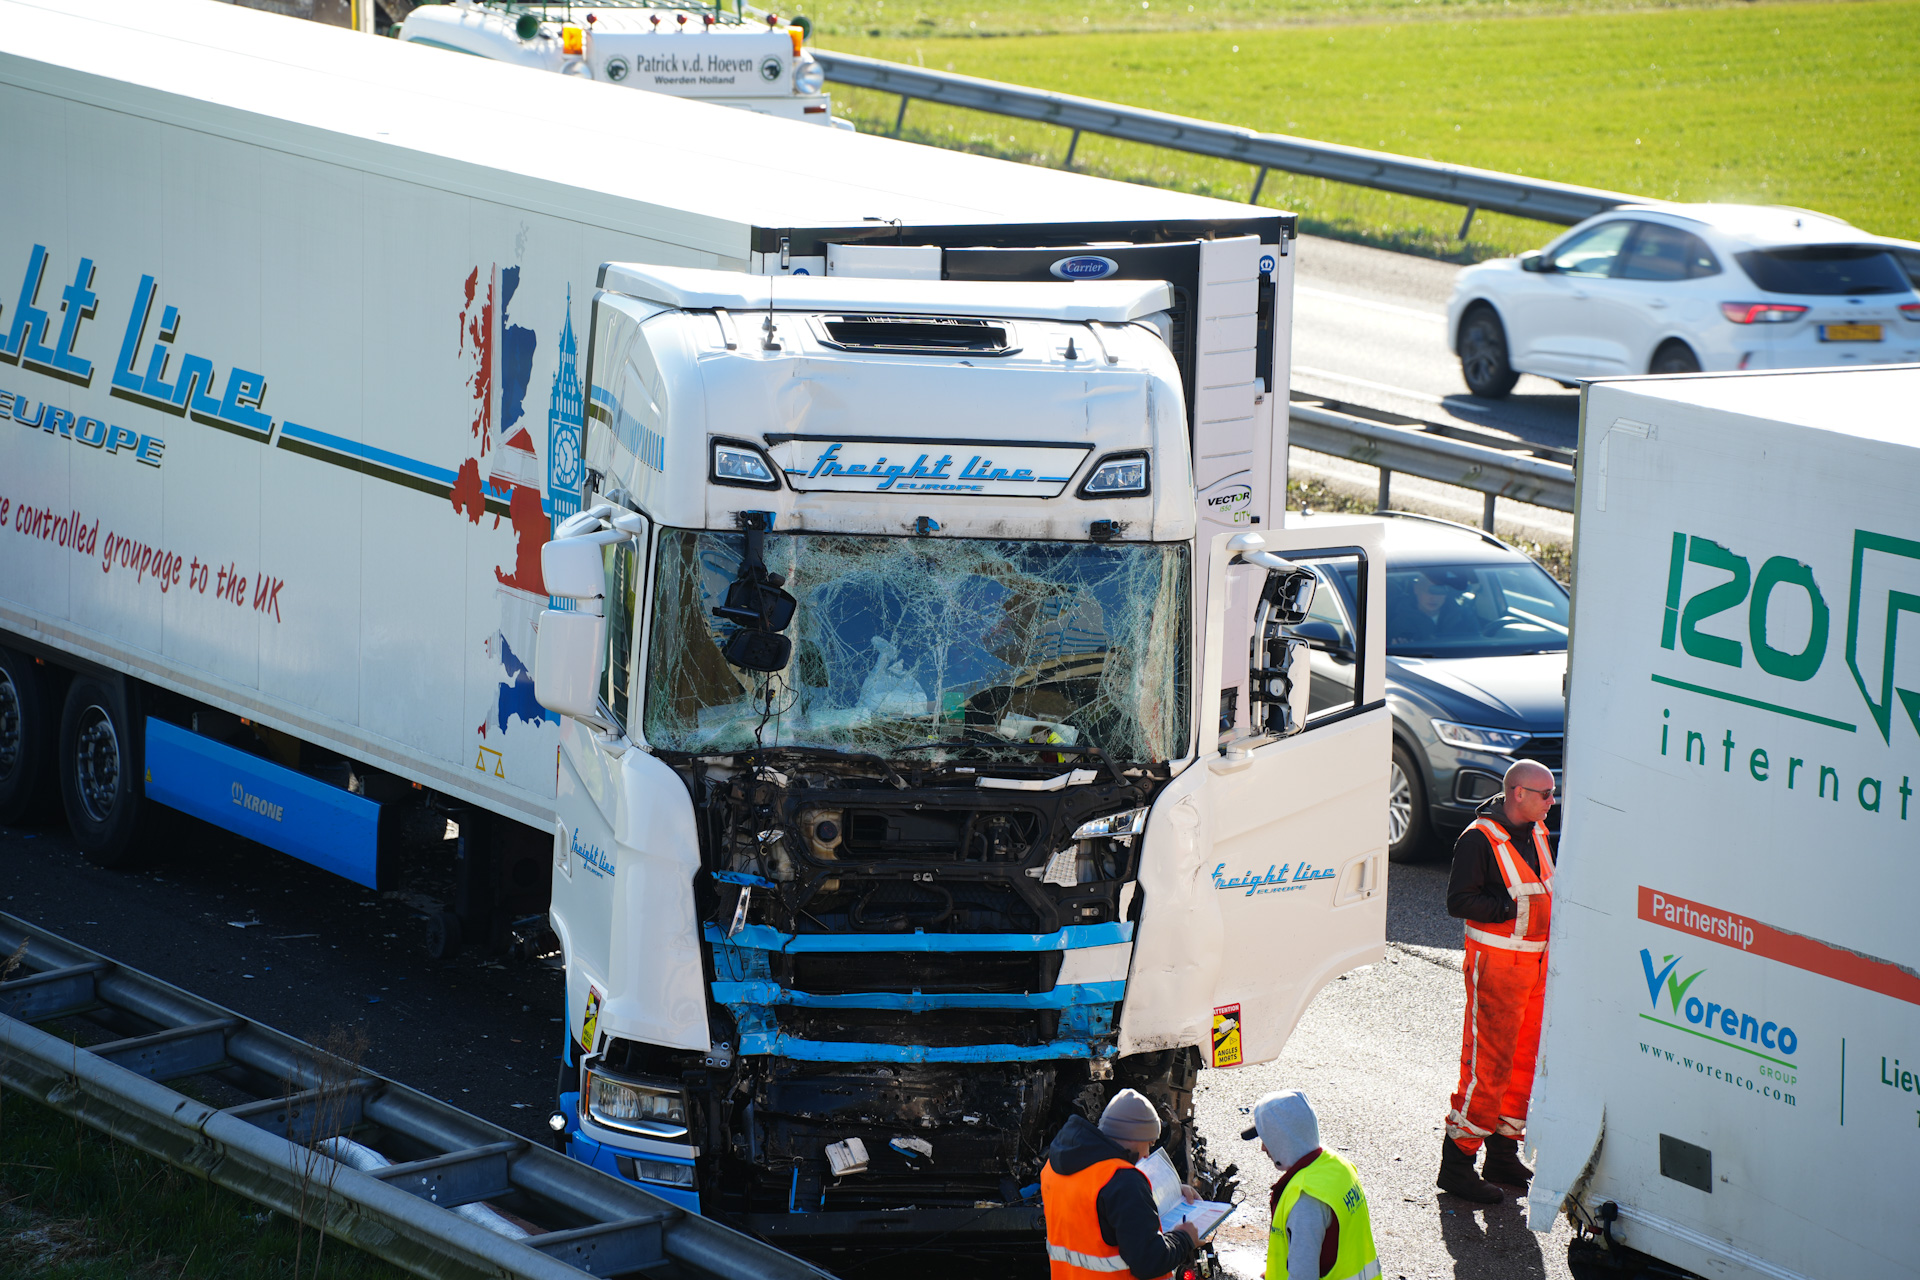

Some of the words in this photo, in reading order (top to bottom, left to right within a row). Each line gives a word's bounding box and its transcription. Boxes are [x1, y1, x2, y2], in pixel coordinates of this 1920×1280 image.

[636, 54, 678, 73] Patrick
[682, 54, 704, 73] v.d.
[707, 54, 753, 73] Hoeven
[654, 76, 696, 85] Woerden
[699, 76, 735, 85] Holland
[1067, 262, 1103, 274] Carrier
[0, 389, 166, 469] EUROPE
[896, 483, 985, 492] EUROPE
[1207, 492, 1250, 506] VECTOR
[1233, 510, 1251, 522] CITY
[15, 502, 99, 557] controlled
[102, 531, 182, 593] groupage
[189, 555, 209, 594] to
[216, 562, 247, 607] the
[253, 572, 284, 624] UK
[1661, 708, 1912, 821] internat
[243, 792, 284, 822] KRONE
[1256, 884, 1307, 895] EUROPE
[1652, 893, 1754, 950] Partnership
[1214, 1004, 1240, 1015] ATTENTION
[1639, 948, 1798, 1055] Worenco
[1217, 1046, 1238, 1057] ANGLES
[1219, 1053, 1238, 1063] MORTS
[1639, 1042, 1797, 1107] www.worenco.com
[1759, 1065, 1797, 1086] GROUP
